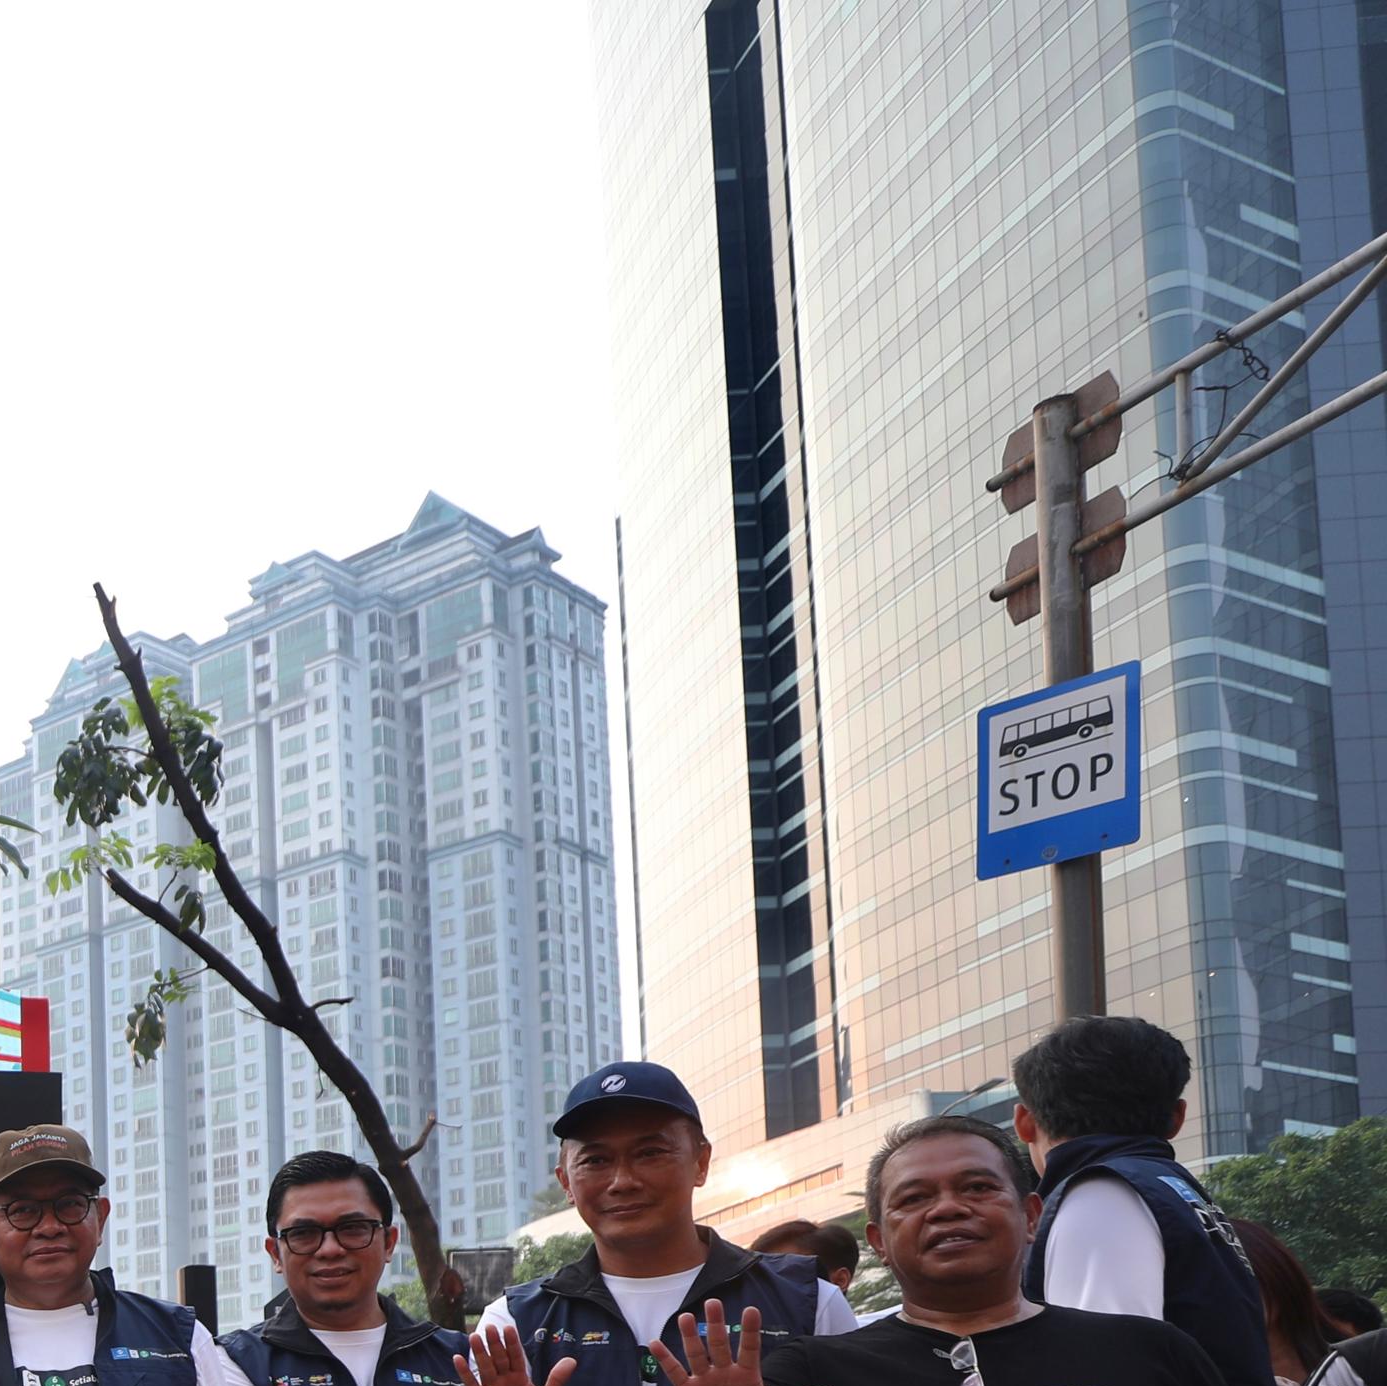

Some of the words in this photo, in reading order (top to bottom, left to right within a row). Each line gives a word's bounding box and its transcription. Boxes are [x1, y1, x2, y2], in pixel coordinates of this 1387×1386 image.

[998, 753, 1114, 816] STOP
[9, 1138, 30, 1150] JAGA
[31, 1133, 67, 1143] JAKARTA
[647, 1355, 654, 1364] 6
[51, 1375, 59, 1384] 6
